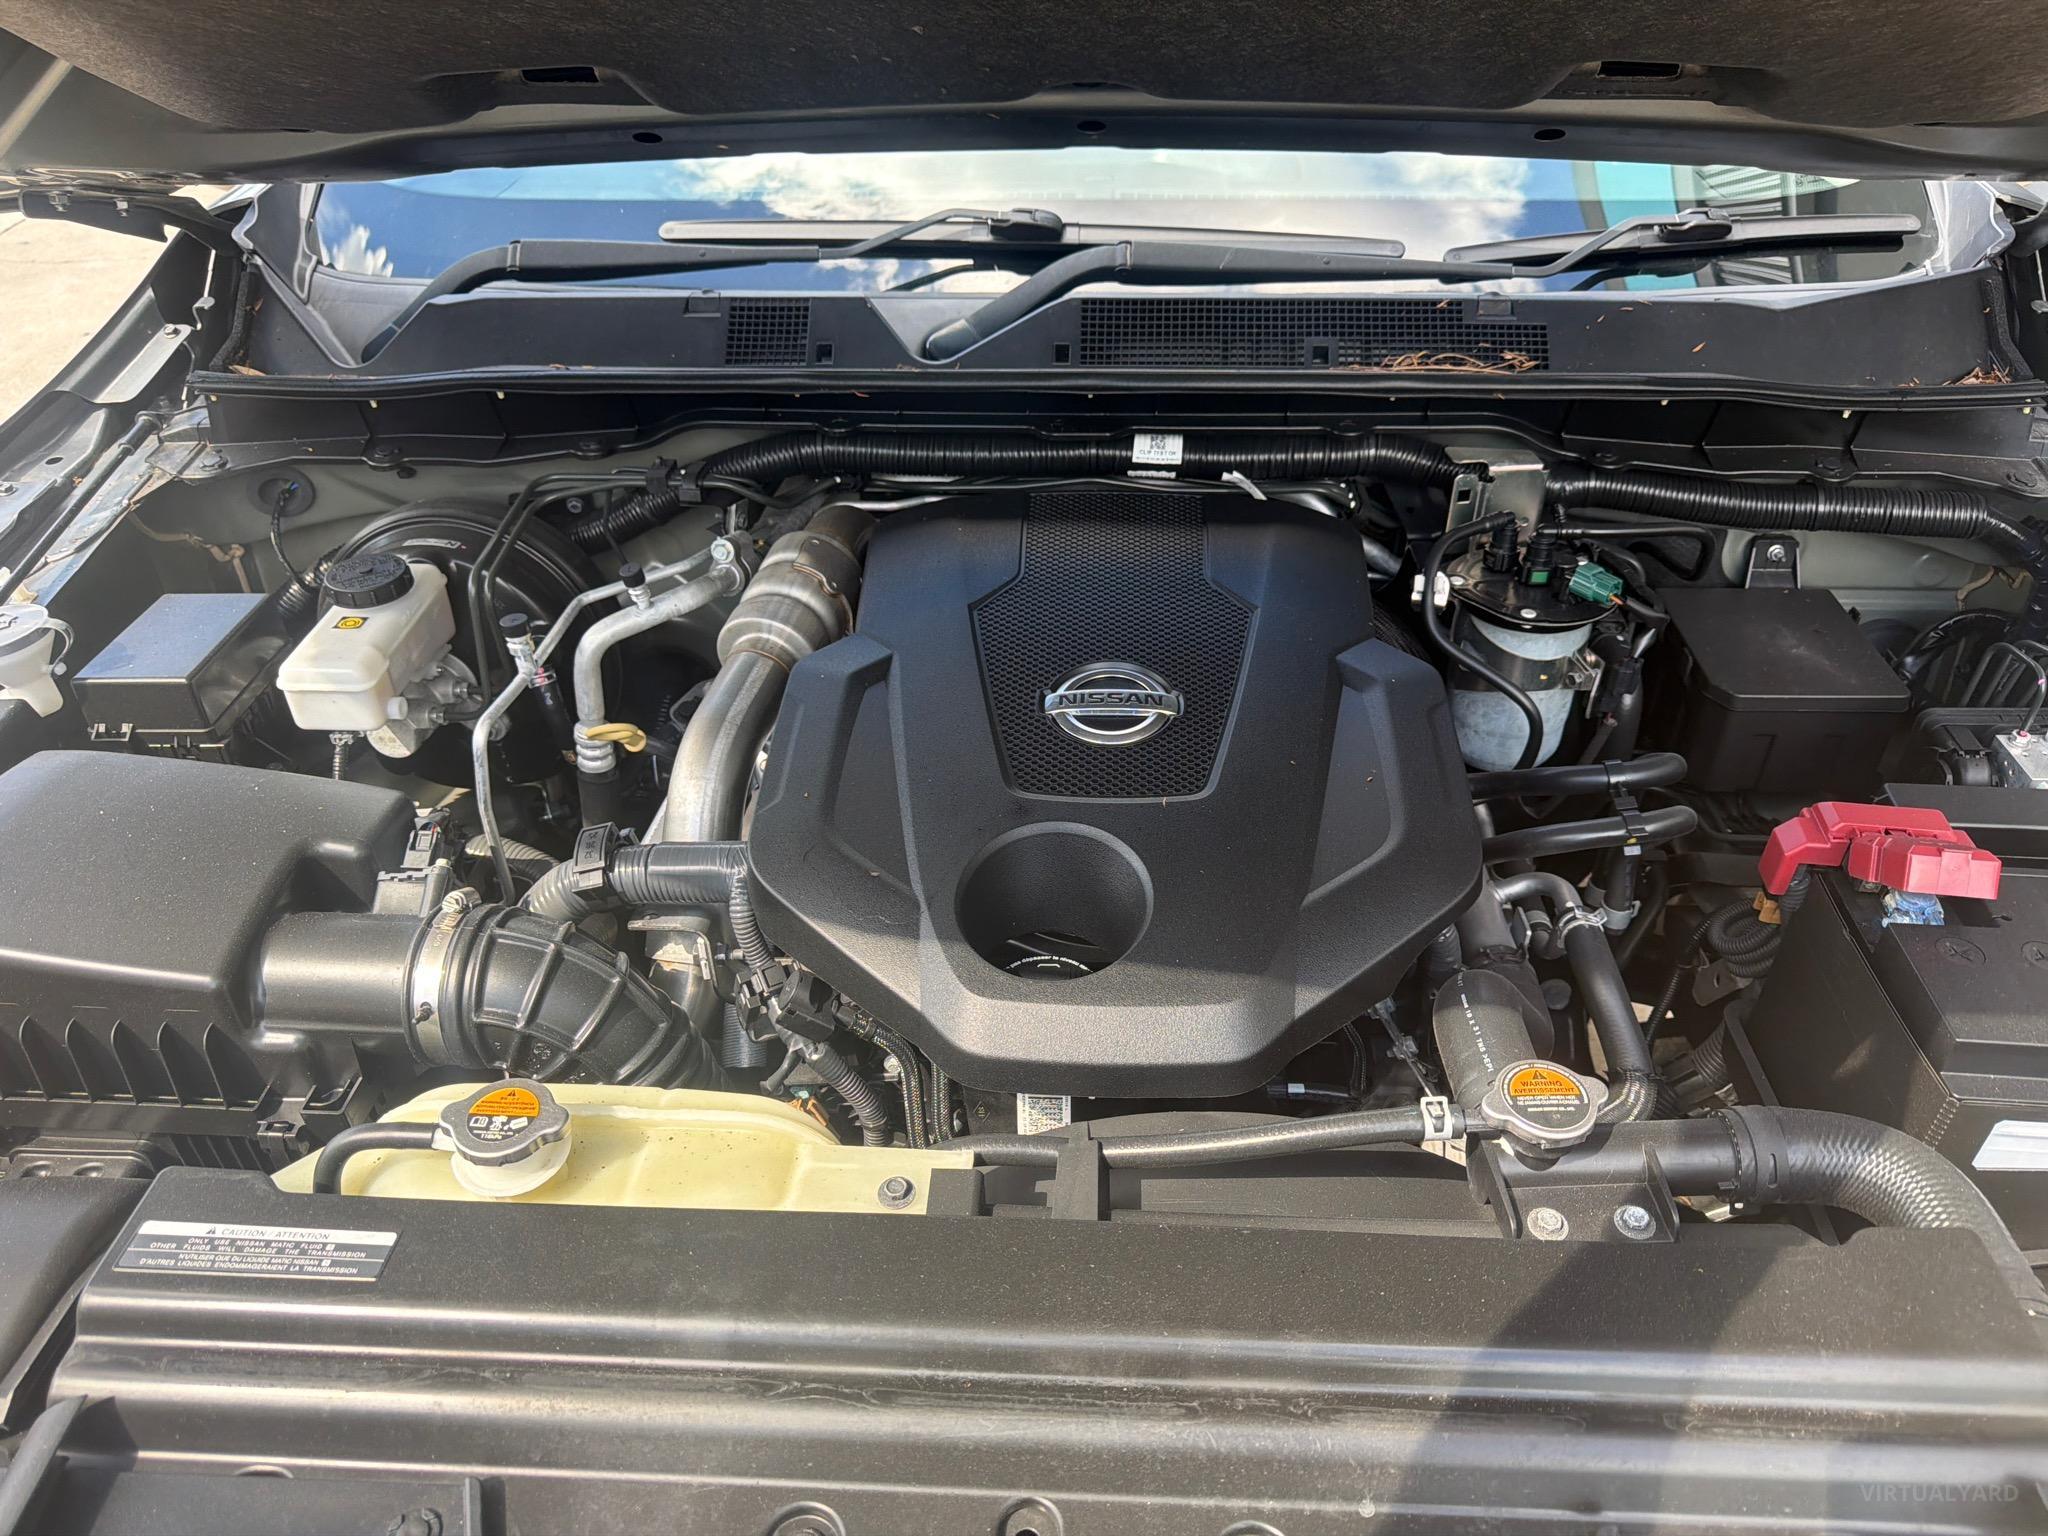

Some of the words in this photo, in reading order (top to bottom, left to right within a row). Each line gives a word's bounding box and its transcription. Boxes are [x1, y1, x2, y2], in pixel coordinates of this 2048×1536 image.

[1058, 692, 1164, 706] NISSAN
[1520, 1080, 1563, 1088] WARNING
[1514, 1087, 1576, 1095] AVERTISSEMENT
[221, 1228, 266, 1238] CAUTION
[275, 1231, 330, 1240] ATTENTION
[270, 1241, 296, 1249] MATIC
[307, 1250, 367, 1258] TRANSMISSION
[303, 1266, 359, 1275] TRANSMISSION
